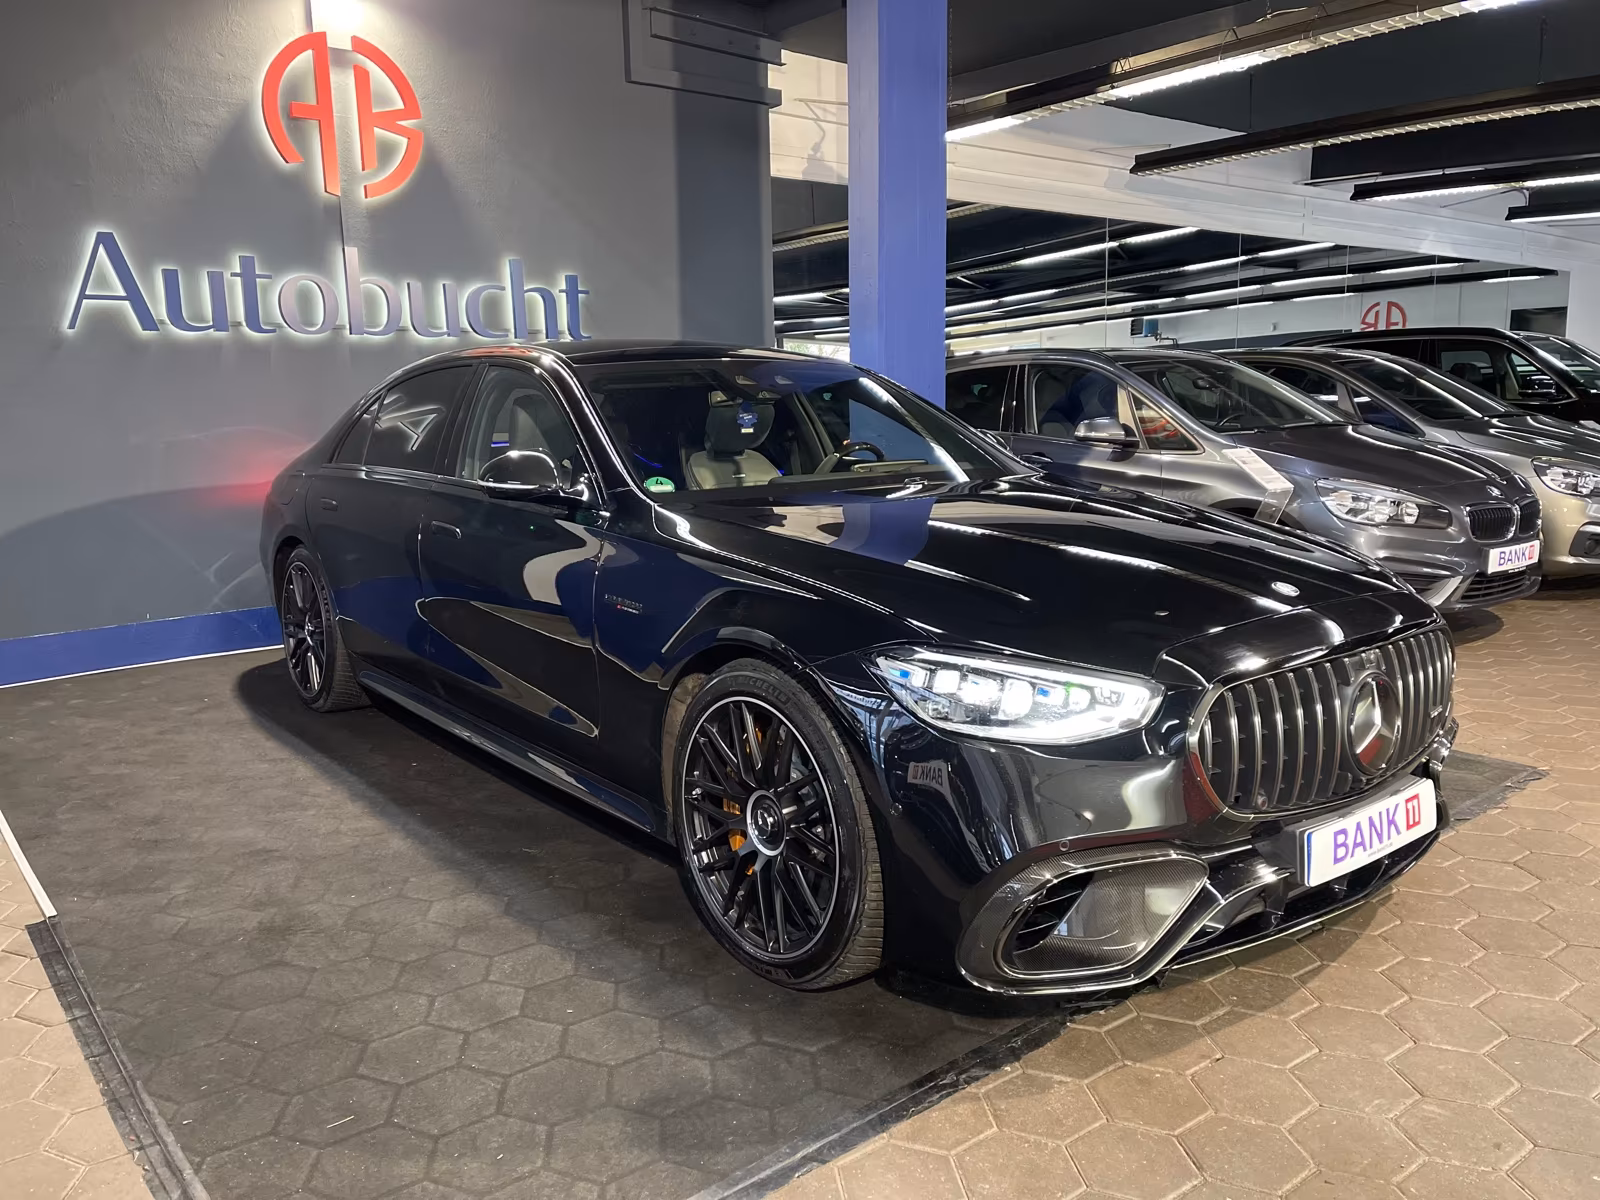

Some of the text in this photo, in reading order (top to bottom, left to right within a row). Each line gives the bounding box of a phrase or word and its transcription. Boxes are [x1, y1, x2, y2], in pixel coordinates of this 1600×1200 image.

[261, 31, 424, 199] AB
[66, 231, 592, 341] Autobucht
[655, 478, 663, 486] 4
[1498, 546, 1528, 567] BANK
[1333, 803, 1402, 866] BANK
